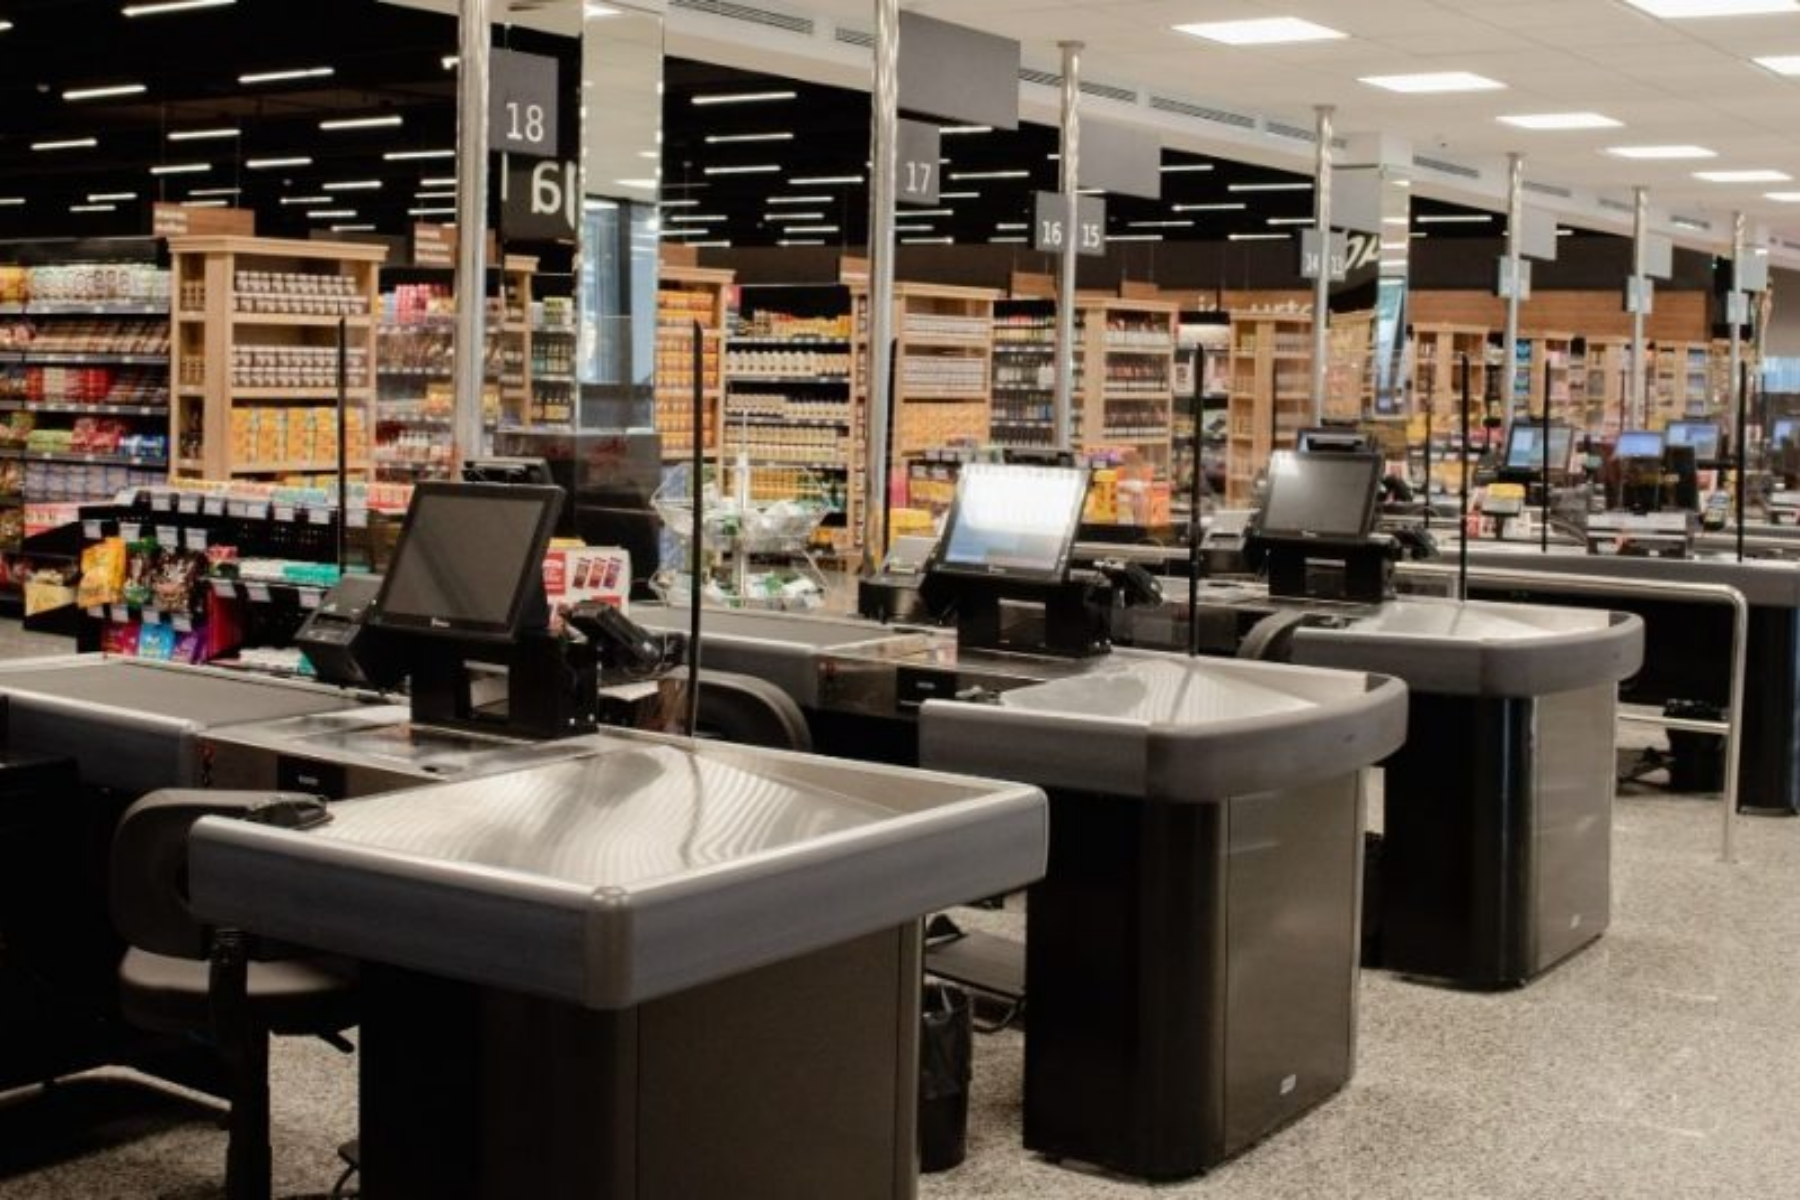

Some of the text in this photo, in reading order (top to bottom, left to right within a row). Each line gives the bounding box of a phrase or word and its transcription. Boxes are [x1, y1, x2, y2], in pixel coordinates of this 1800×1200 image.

[506, 102, 544, 142] 18
[906, 161, 931, 194] 17
[1043, 221, 1062, 245] 16
[1083, 224, 1100, 247] 15
